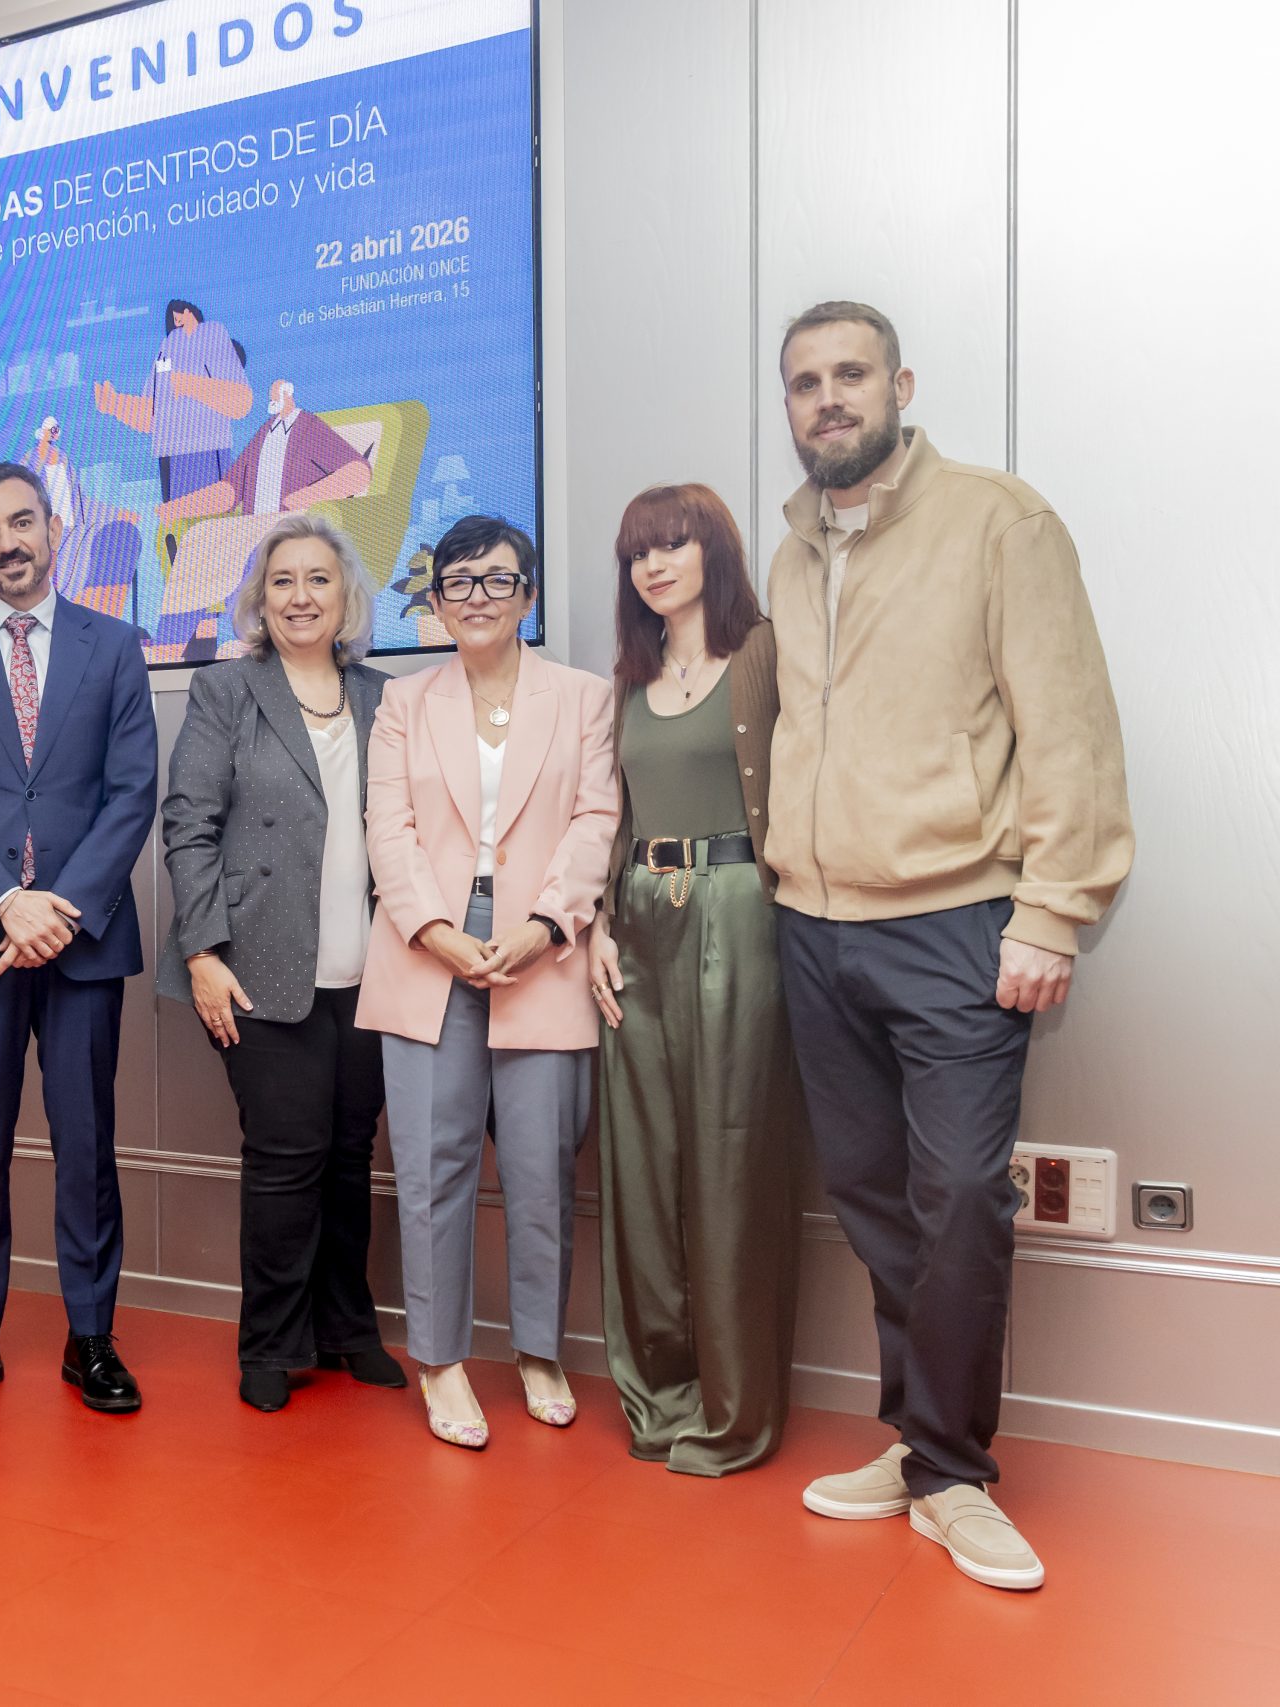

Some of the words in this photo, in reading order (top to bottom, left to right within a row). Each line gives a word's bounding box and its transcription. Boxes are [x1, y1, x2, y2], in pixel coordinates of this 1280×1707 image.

[53, 173, 96, 211] DE
[102, 134, 258, 199] CENTROS
[271, 120, 317, 161] DE
[329, 100, 388, 149] DÍA
[11, 206, 157, 266] prevención,
[167, 178, 279, 227] cuidado
[289, 176, 306, 208] y
[314, 156, 376, 193] vida
[315, 240, 344, 270] 22
[350, 229, 402, 264] abril
[410, 215, 470, 252] 2026
[340, 261, 424, 295] FUNDACIÓN
[429, 255, 470, 279] ONCE
[279, 311, 294, 329] C/
[298, 307, 314, 326] de
[318, 295, 387, 322] Sebastián
[390, 285, 448, 309] Herrera,
[451, 281, 470, 299] 15
